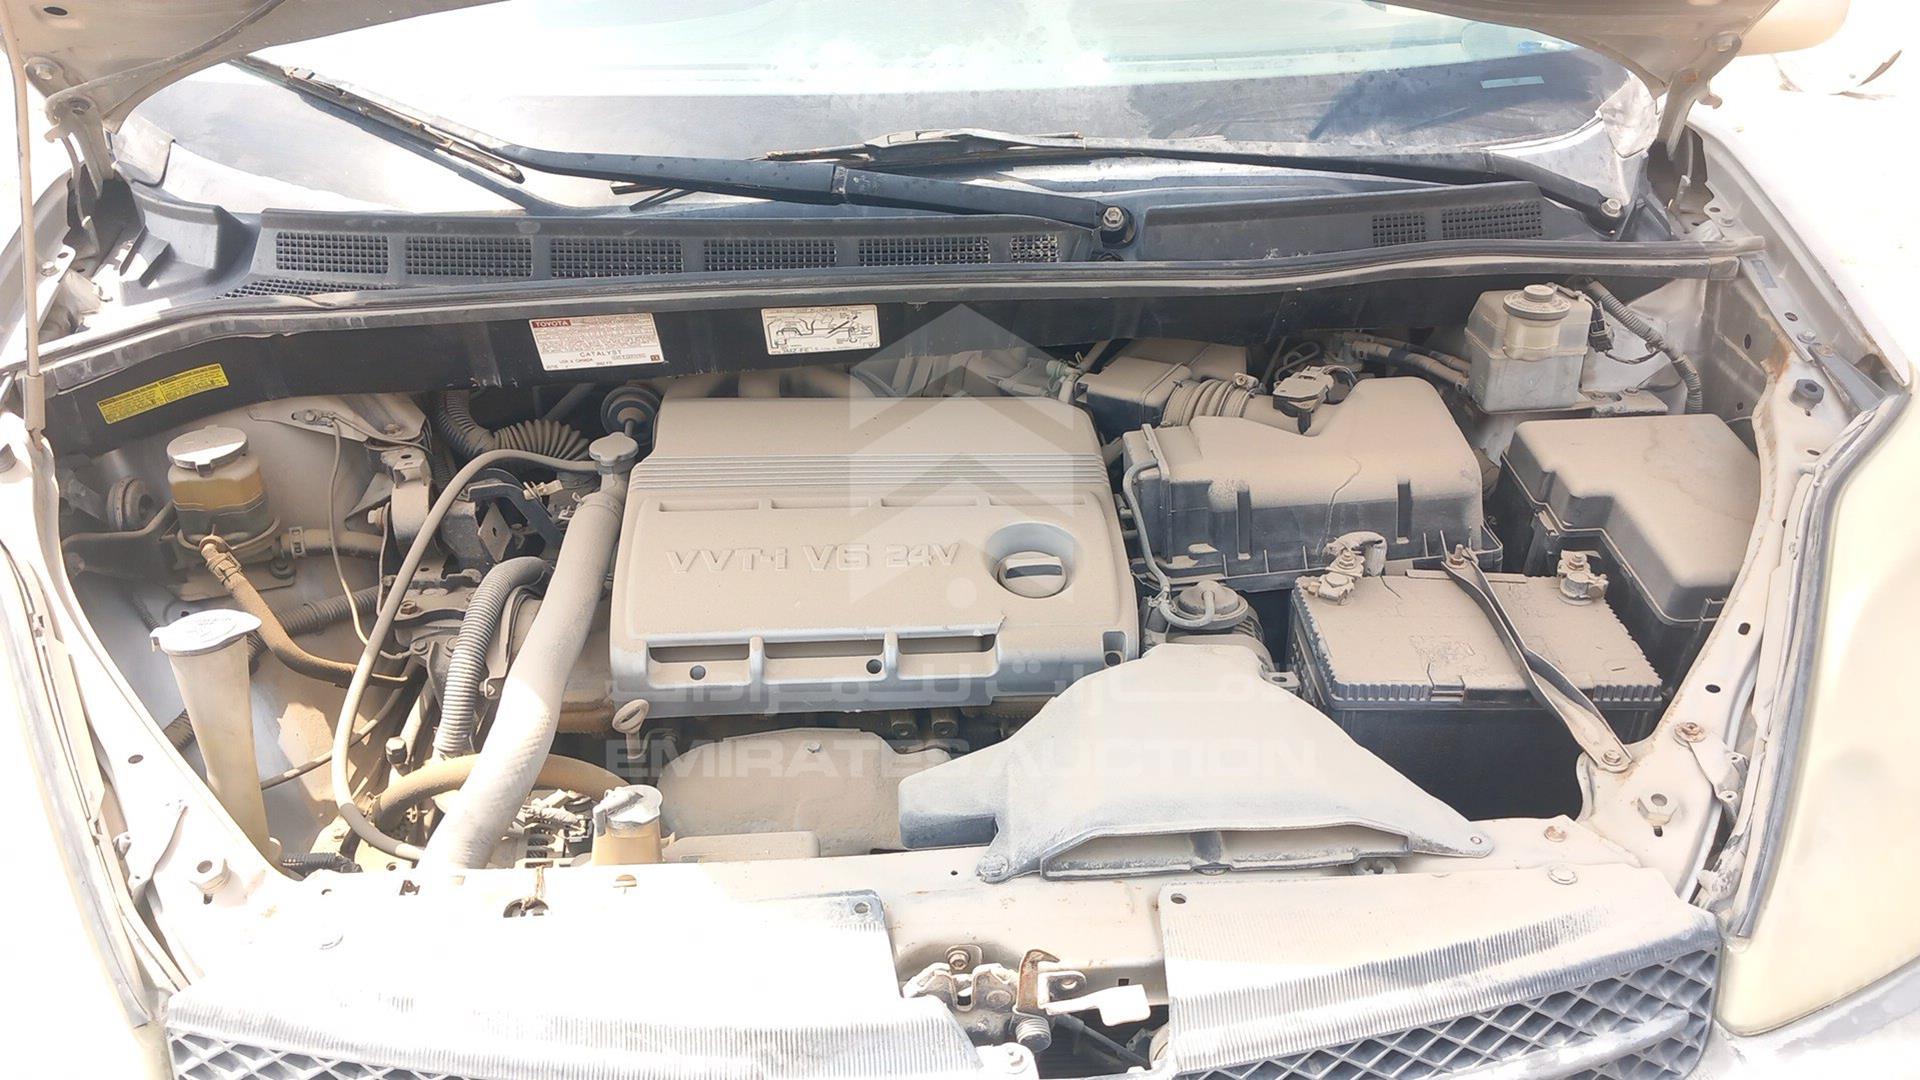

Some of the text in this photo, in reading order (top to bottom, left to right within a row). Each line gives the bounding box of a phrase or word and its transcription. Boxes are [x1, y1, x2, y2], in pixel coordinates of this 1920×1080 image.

[579, 349, 622, 358] CATALYST
[802, 543, 870, 571] V6
[886, 543, 960, 568] 24V
